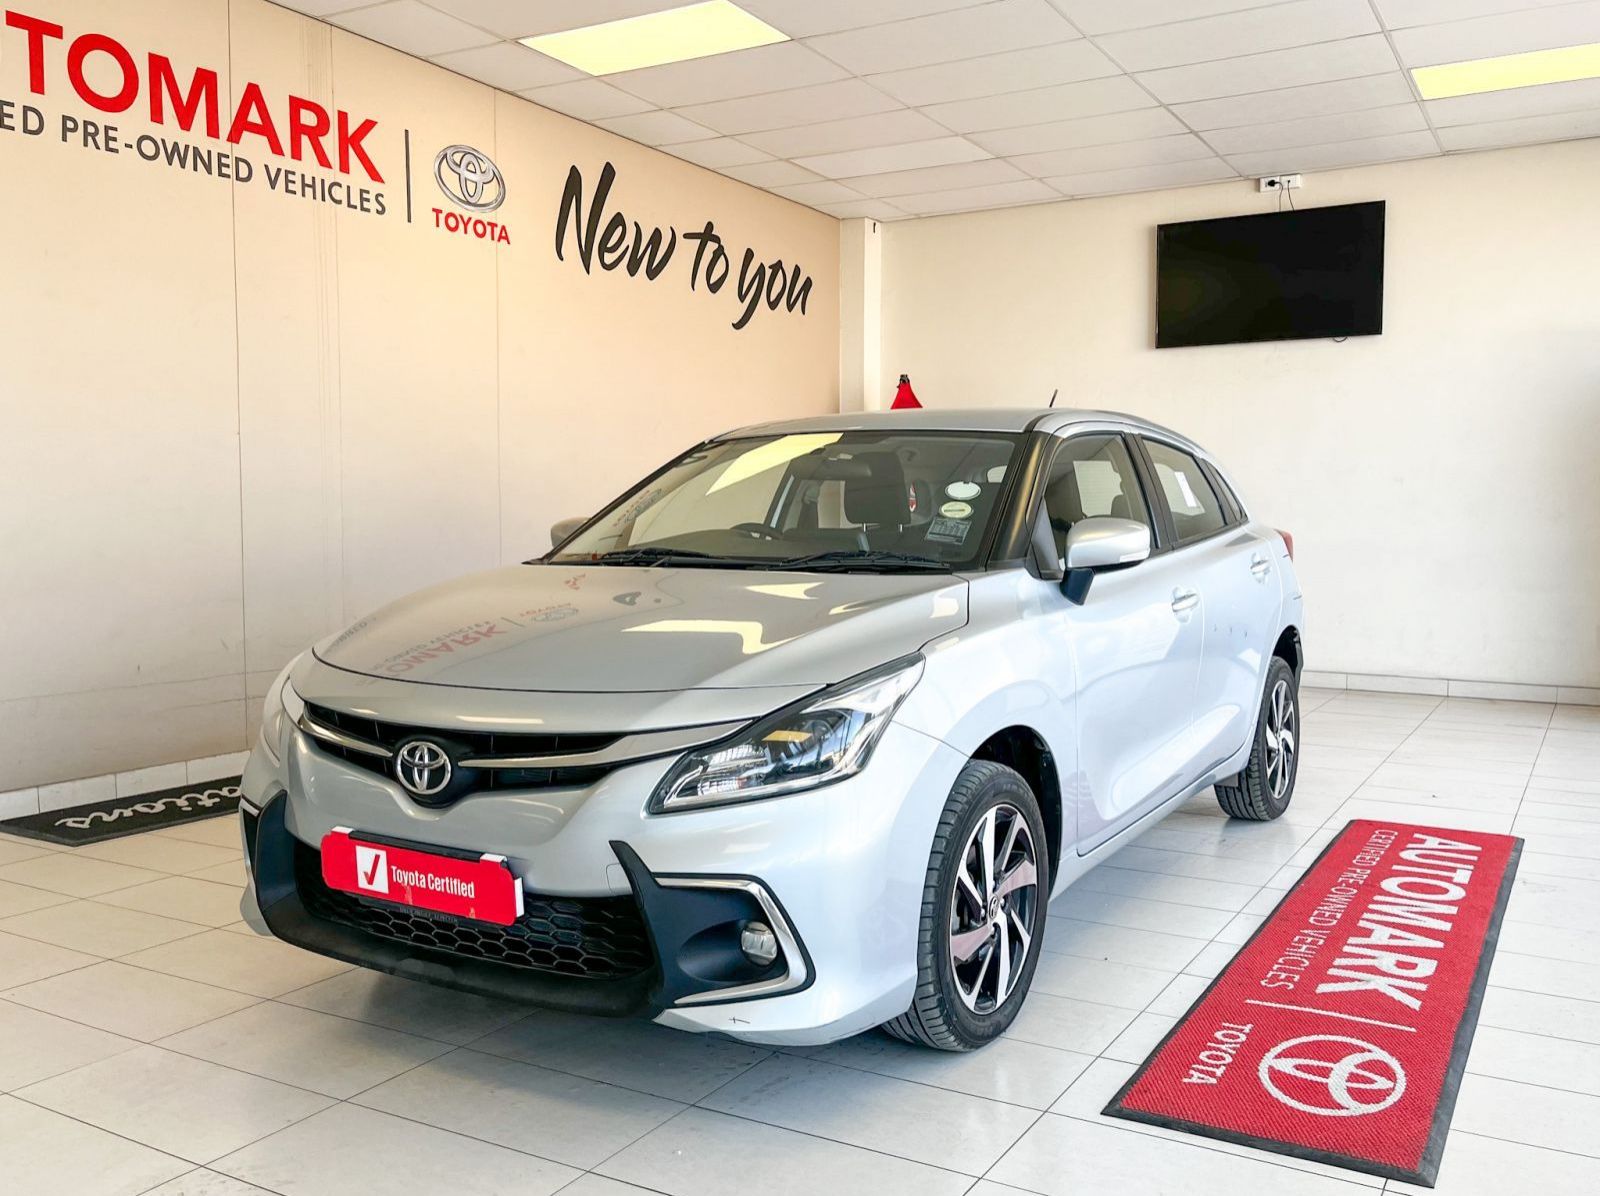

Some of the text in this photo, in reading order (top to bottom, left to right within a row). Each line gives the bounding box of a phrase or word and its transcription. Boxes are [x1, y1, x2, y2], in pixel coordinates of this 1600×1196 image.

[61, 114, 252, 183] PRE-OWNED
[263, 164, 386, 215] VEHICLES
[431, 207, 510, 245] TOYOTA
[555, 161, 813, 330] New to you
[391, 865, 475, 899] Toyota Certified
[1260, 829, 1399, 991] CERTIFIED PRE-OWNED VEHICLES
[1314, 832, 1483, 1012] AUTOMARK
[1182, 1021, 1254, 1084] TOYOTA
